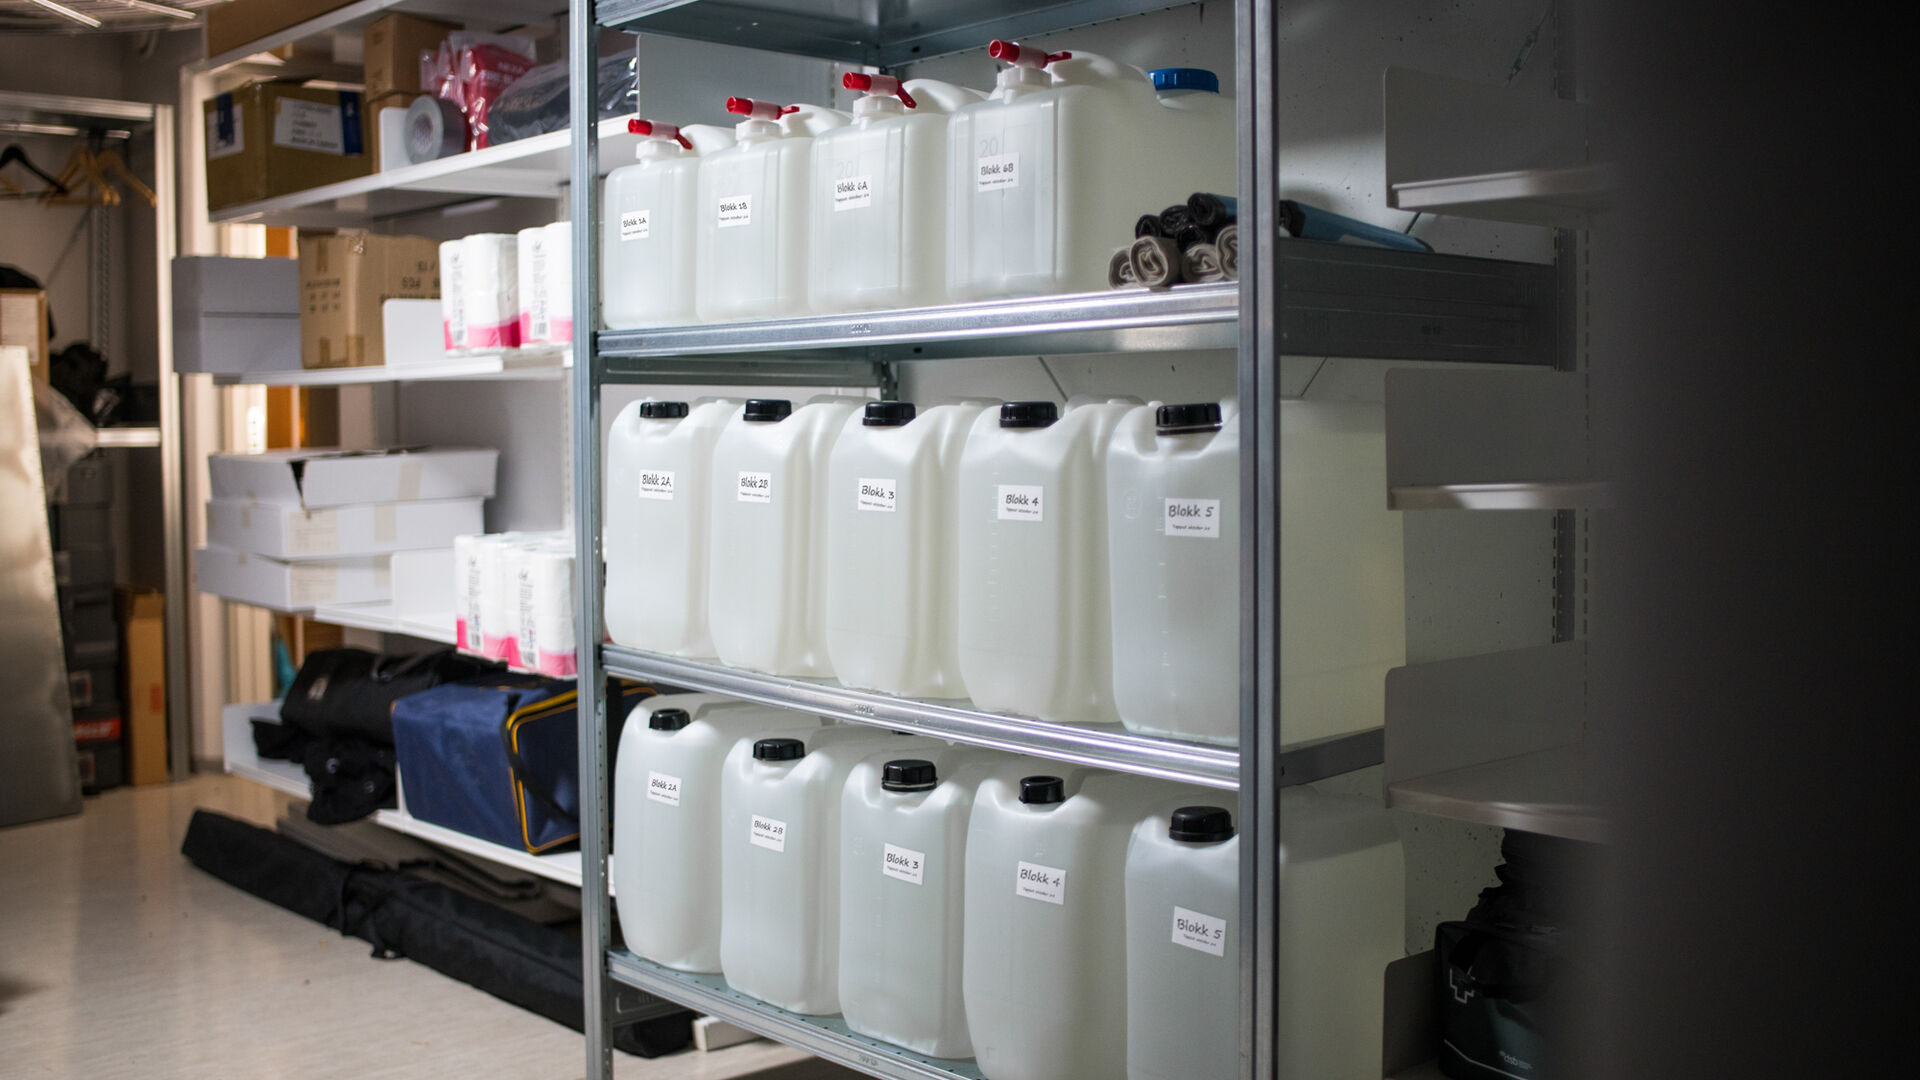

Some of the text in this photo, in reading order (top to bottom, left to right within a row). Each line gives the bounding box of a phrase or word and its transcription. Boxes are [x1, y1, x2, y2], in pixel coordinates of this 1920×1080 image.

[981, 164, 1001, 175] Blokk
[837, 181, 855, 193] Blokk
[720, 202, 737, 212] Blokk
[623, 219, 638, 227] Blokk
[642, 473, 672, 487] Blokk 2A
[741, 476, 769, 489] Blokk 2B
[861, 485, 895, 500] Blokk 3
[1006, 493, 1040, 506] Blokk 4
[1168, 504, 1215, 518] Blokk 5
[651, 778, 677, 792] Blokk 2A
[754, 820, 783, 835] Blokk 2B
[886, 853, 919, 870] Blokk 3
[1020, 869, 1061, 887] Blokk 4
[1177, 918, 1209, 937] Blokk
[1213, 929, 1223, 940] 5
